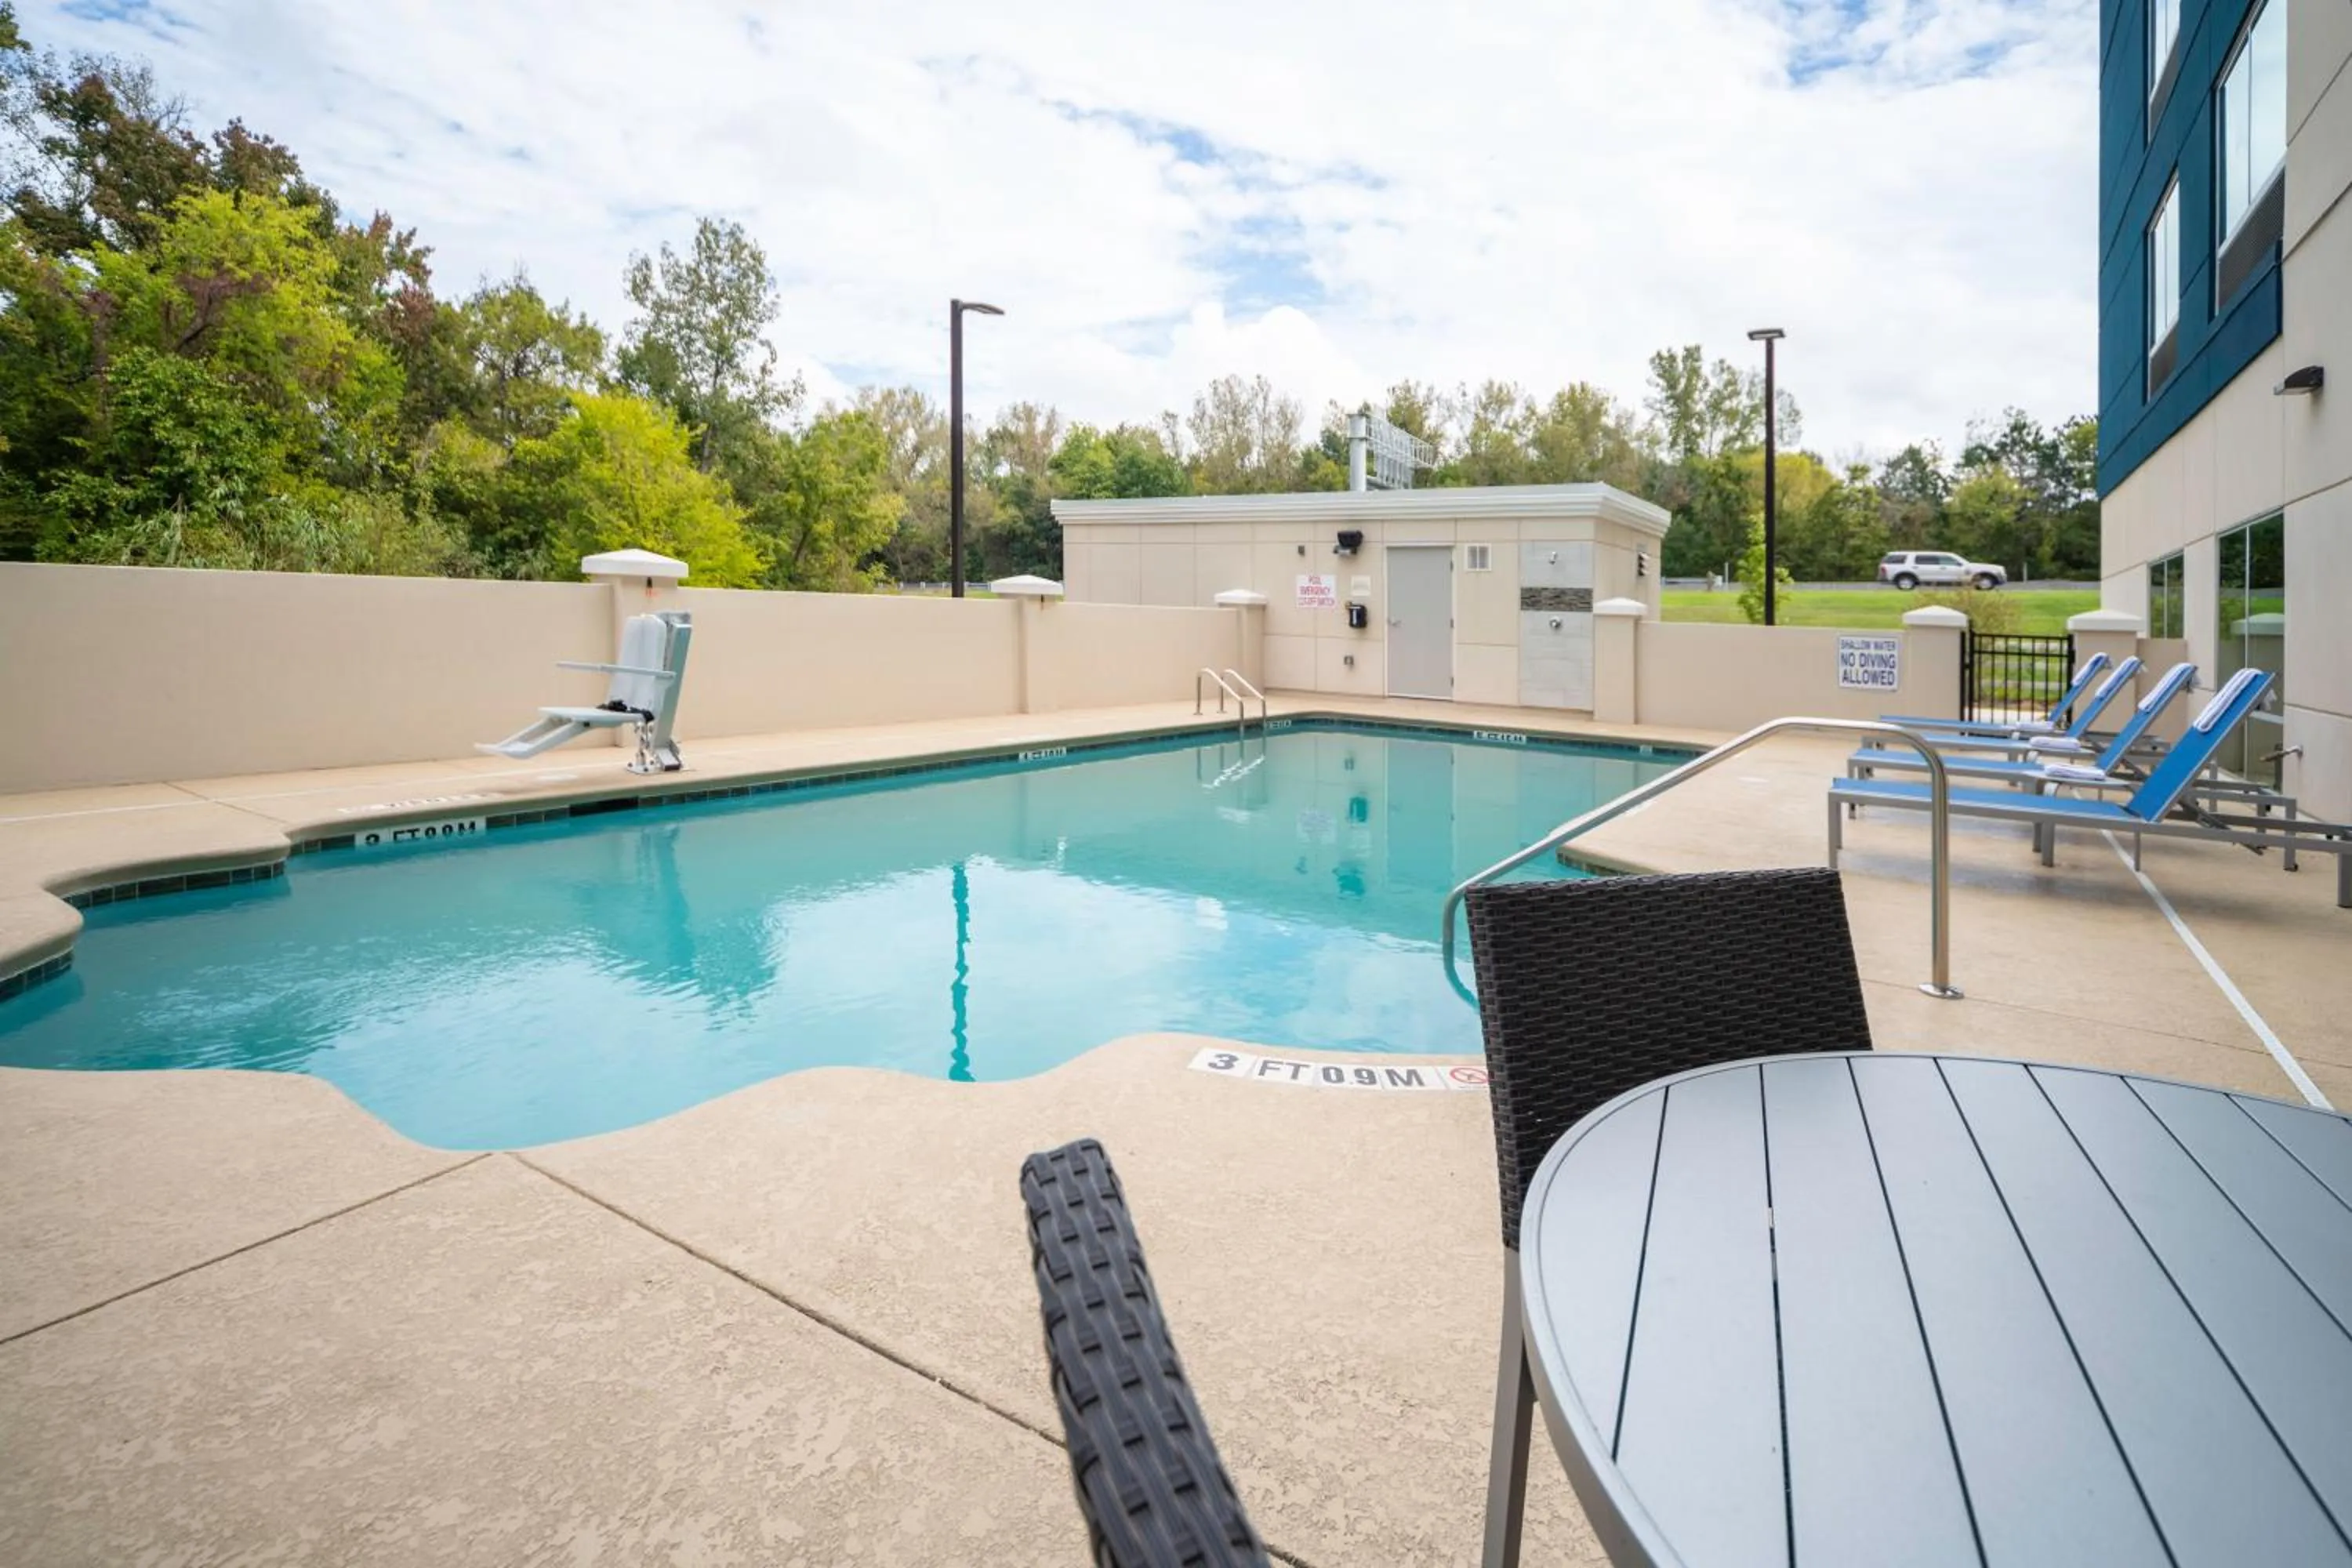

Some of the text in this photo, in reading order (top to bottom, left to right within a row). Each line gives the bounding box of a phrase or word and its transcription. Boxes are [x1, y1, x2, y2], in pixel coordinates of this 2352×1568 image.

[1840, 652, 1896, 669] NO DIVING
[1842, 669, 1895, 686] ALLOWED
[1207, 1053, 1240, 1070] 3
[1258, 1059, 1311, 1080] FT
